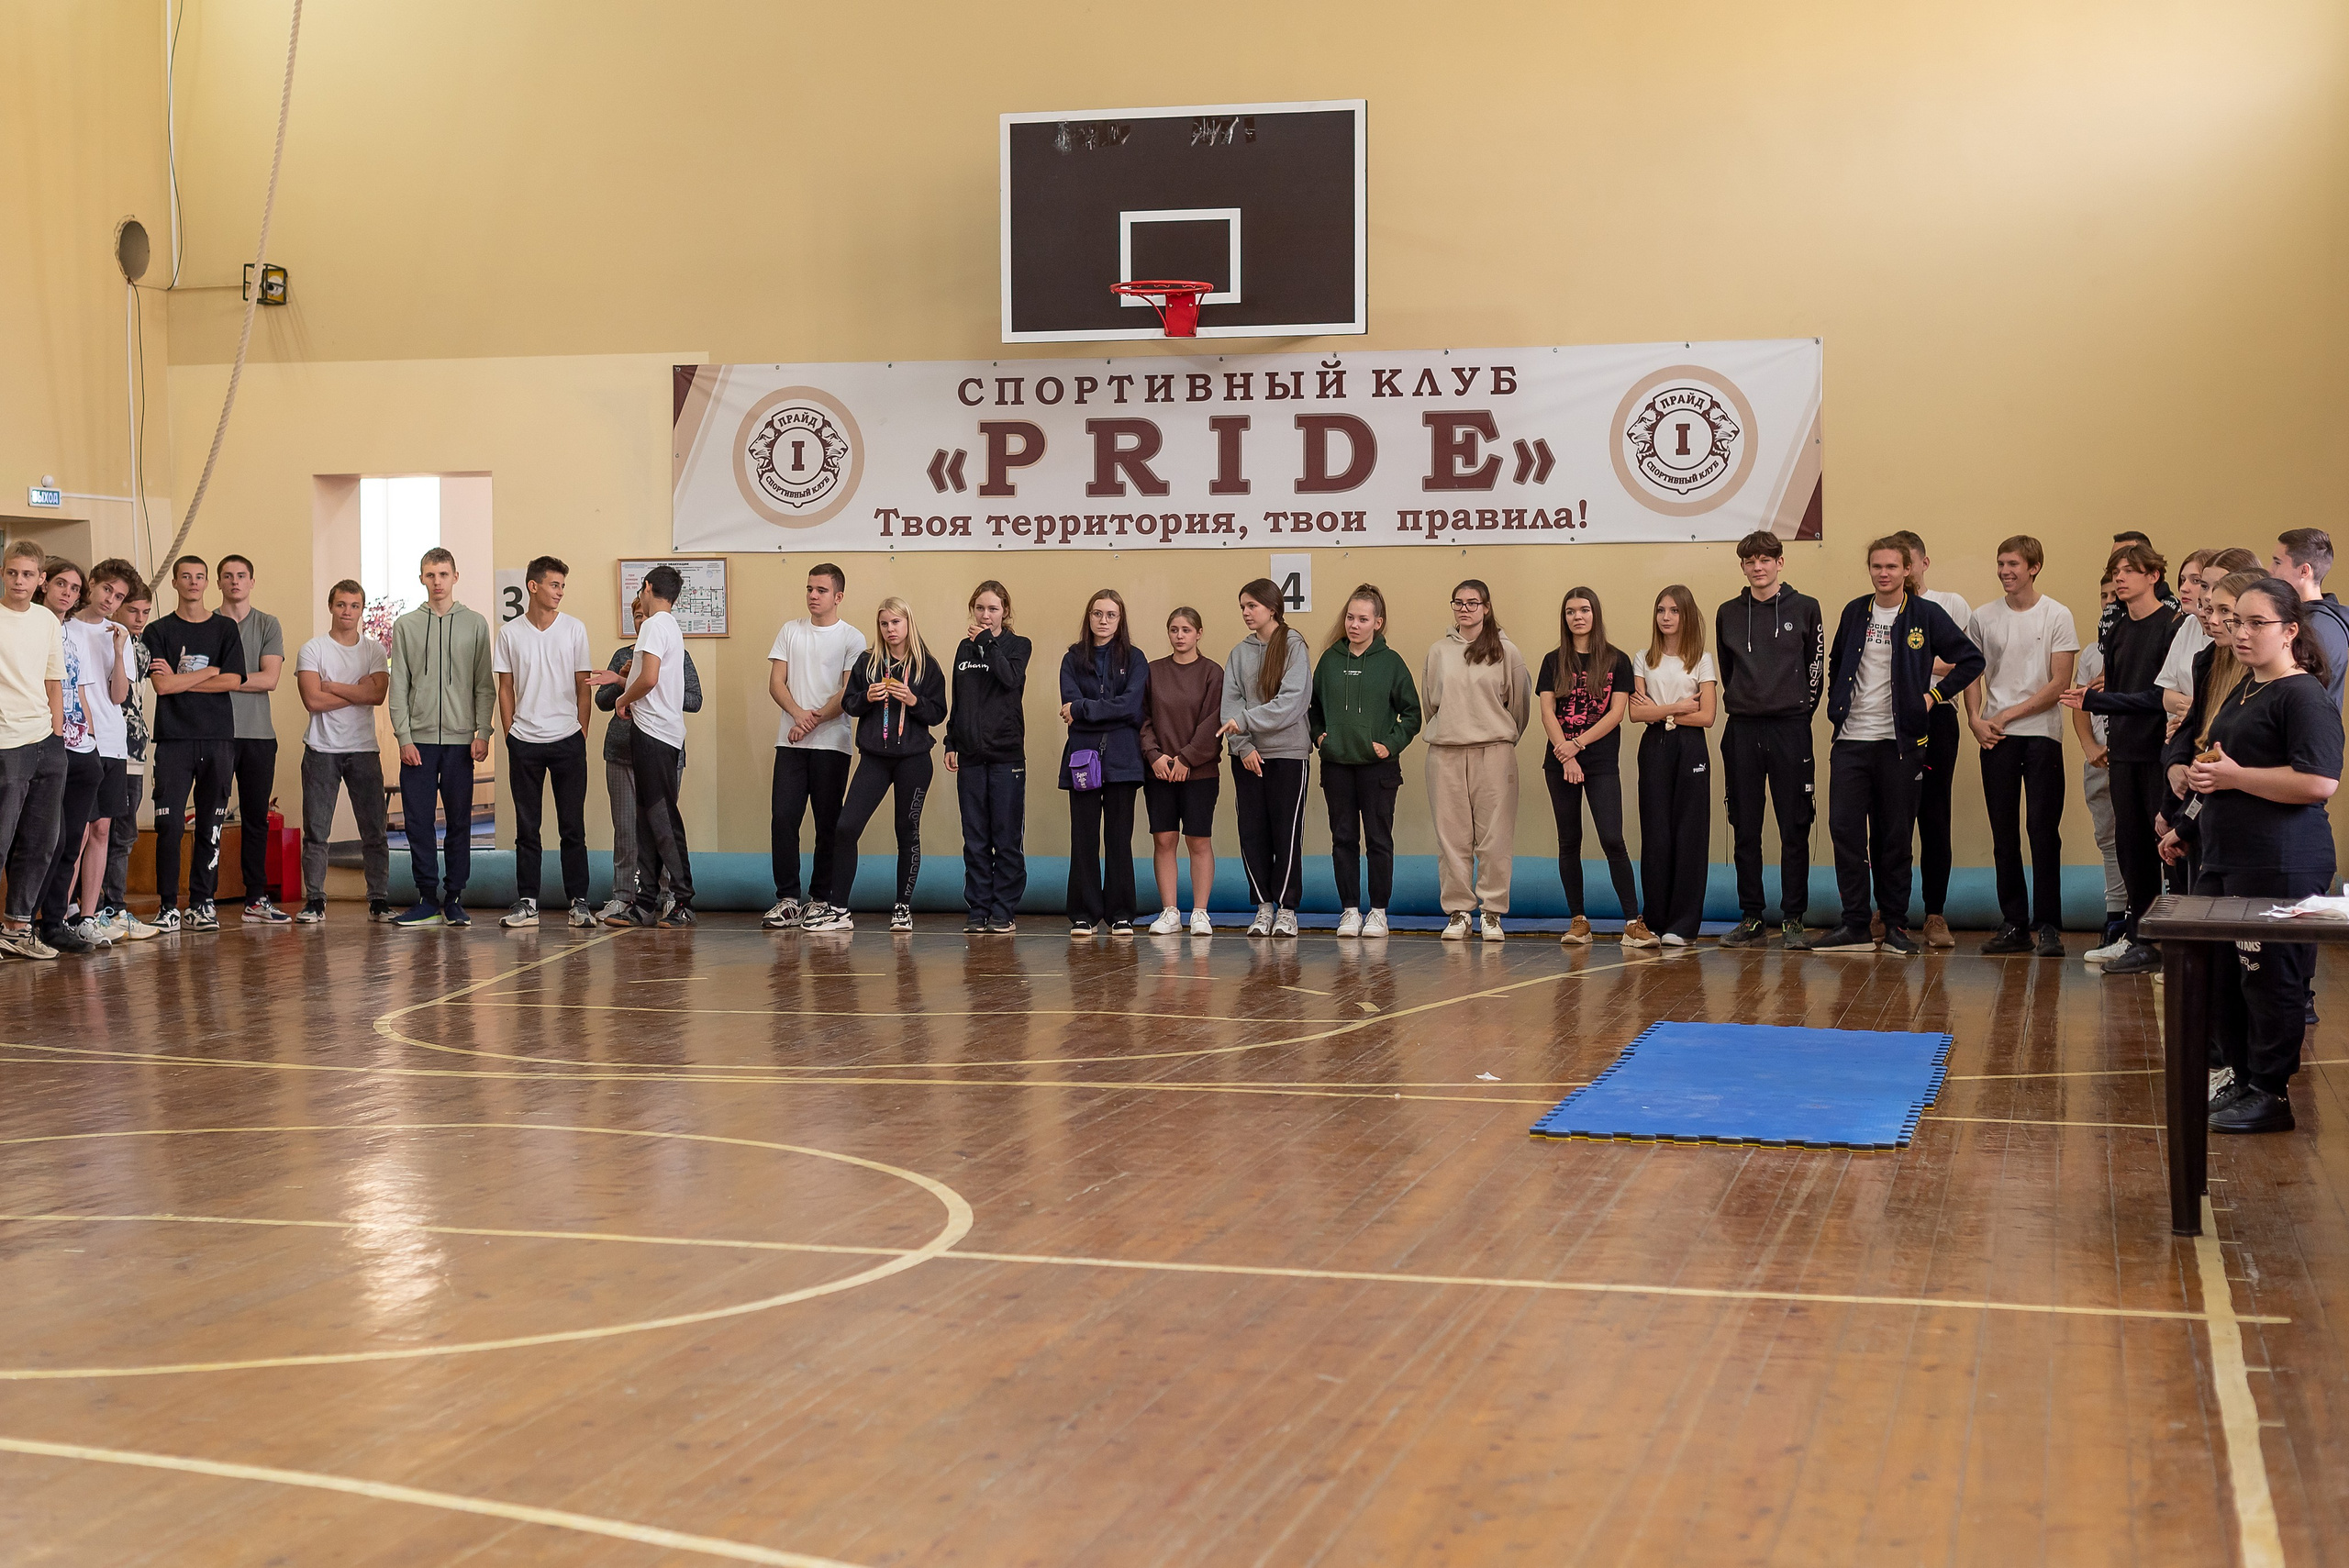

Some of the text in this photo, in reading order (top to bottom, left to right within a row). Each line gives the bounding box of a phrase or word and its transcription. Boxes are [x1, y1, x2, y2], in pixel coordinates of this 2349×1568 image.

[957, 361, 1518, 406] СПОРТИВНЫЙ КЛУБ
[1659, 392, 1706, 410] ПРАЙД
[777, 411, 818, 429] ПРАЙД
[765, 475, 831, 499] СПОРТИВНЫЙ КЛУБ
[1646, 460, 1720, 485] СПОРТИВНЫЙ КЛУБ
[874, 499, 1587, 545] Твоя территория, твои правила!
[502, 585, 525, 622] 3
[1280, 572, 1306, 610] 4
